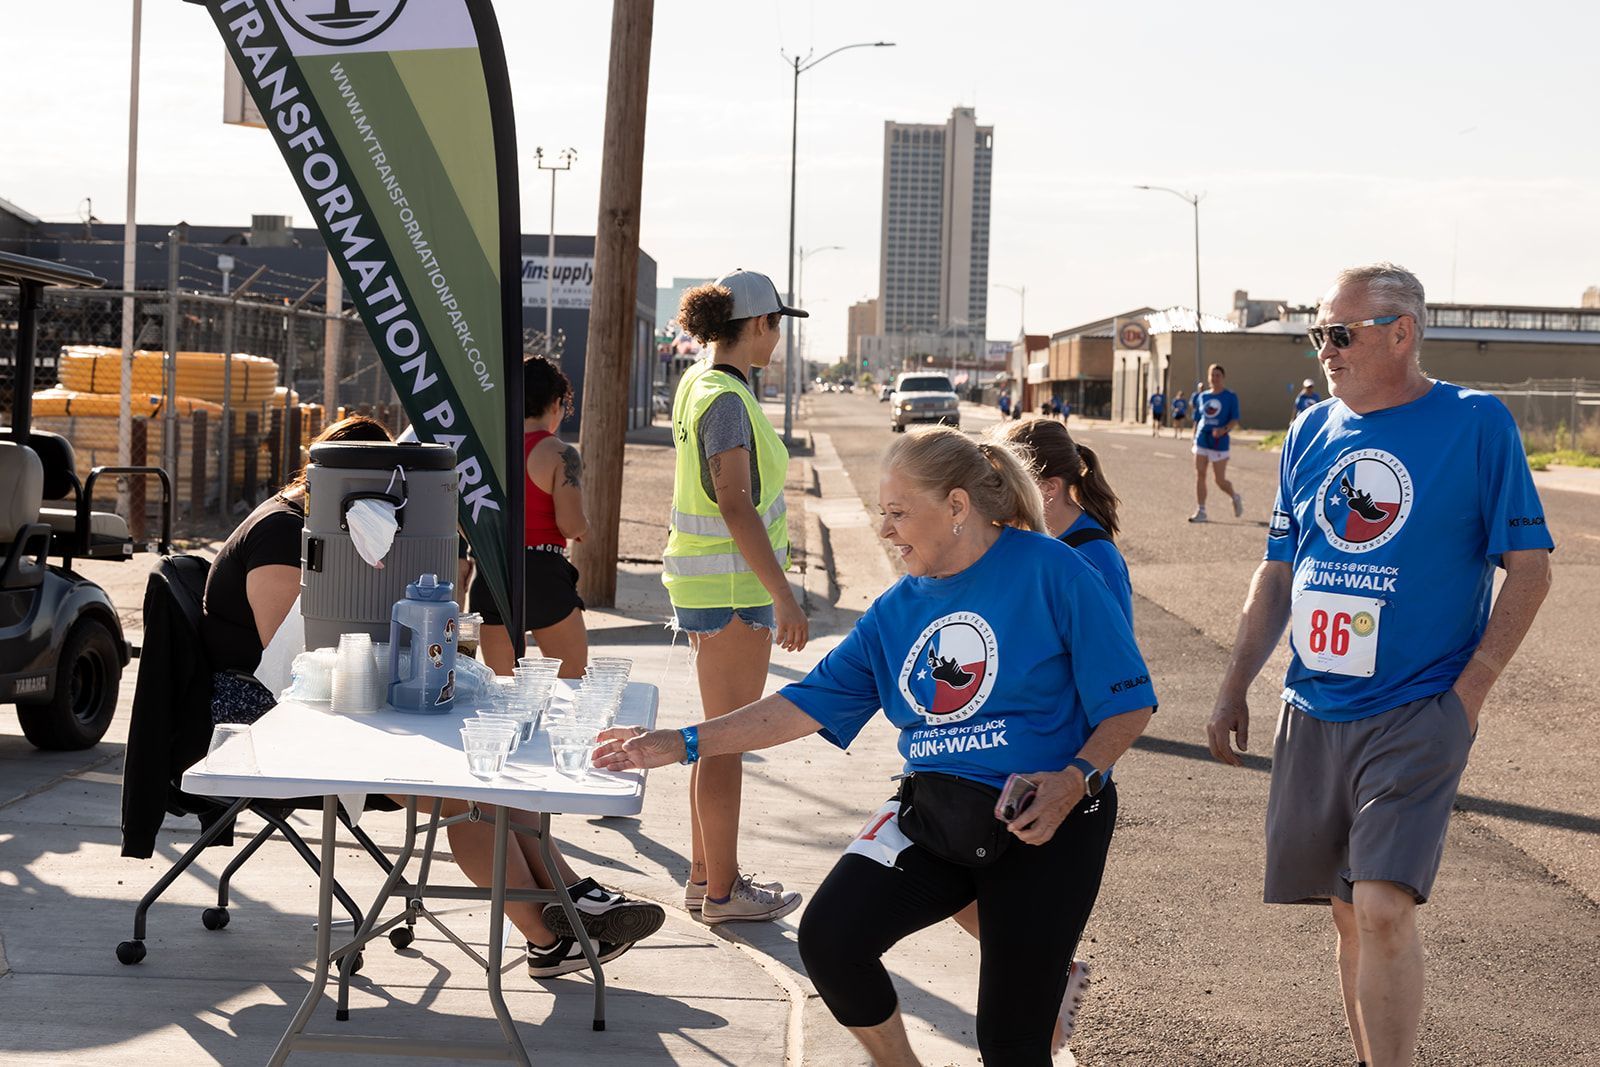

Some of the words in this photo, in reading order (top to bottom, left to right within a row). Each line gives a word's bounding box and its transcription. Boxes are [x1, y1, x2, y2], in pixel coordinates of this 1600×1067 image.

[329, 62, 495, 393] WWW.MYTRANSFORMATIONPARK.COM
[220, 0, 438, 395] TRANSFORMATION
[423, 399, 501, 525] PARK
[1388, 458, 1411, 504] FESTIVAL
[1355, 531, 1393, 551] ANNUAL
[1305, 567, 1397, 592] RUN+WALK
[1309, 609, 1351, 656] 86
[948, 693, 985, 721] ANNUAL
[909, 730, 1009, 759] RUN+WALK
